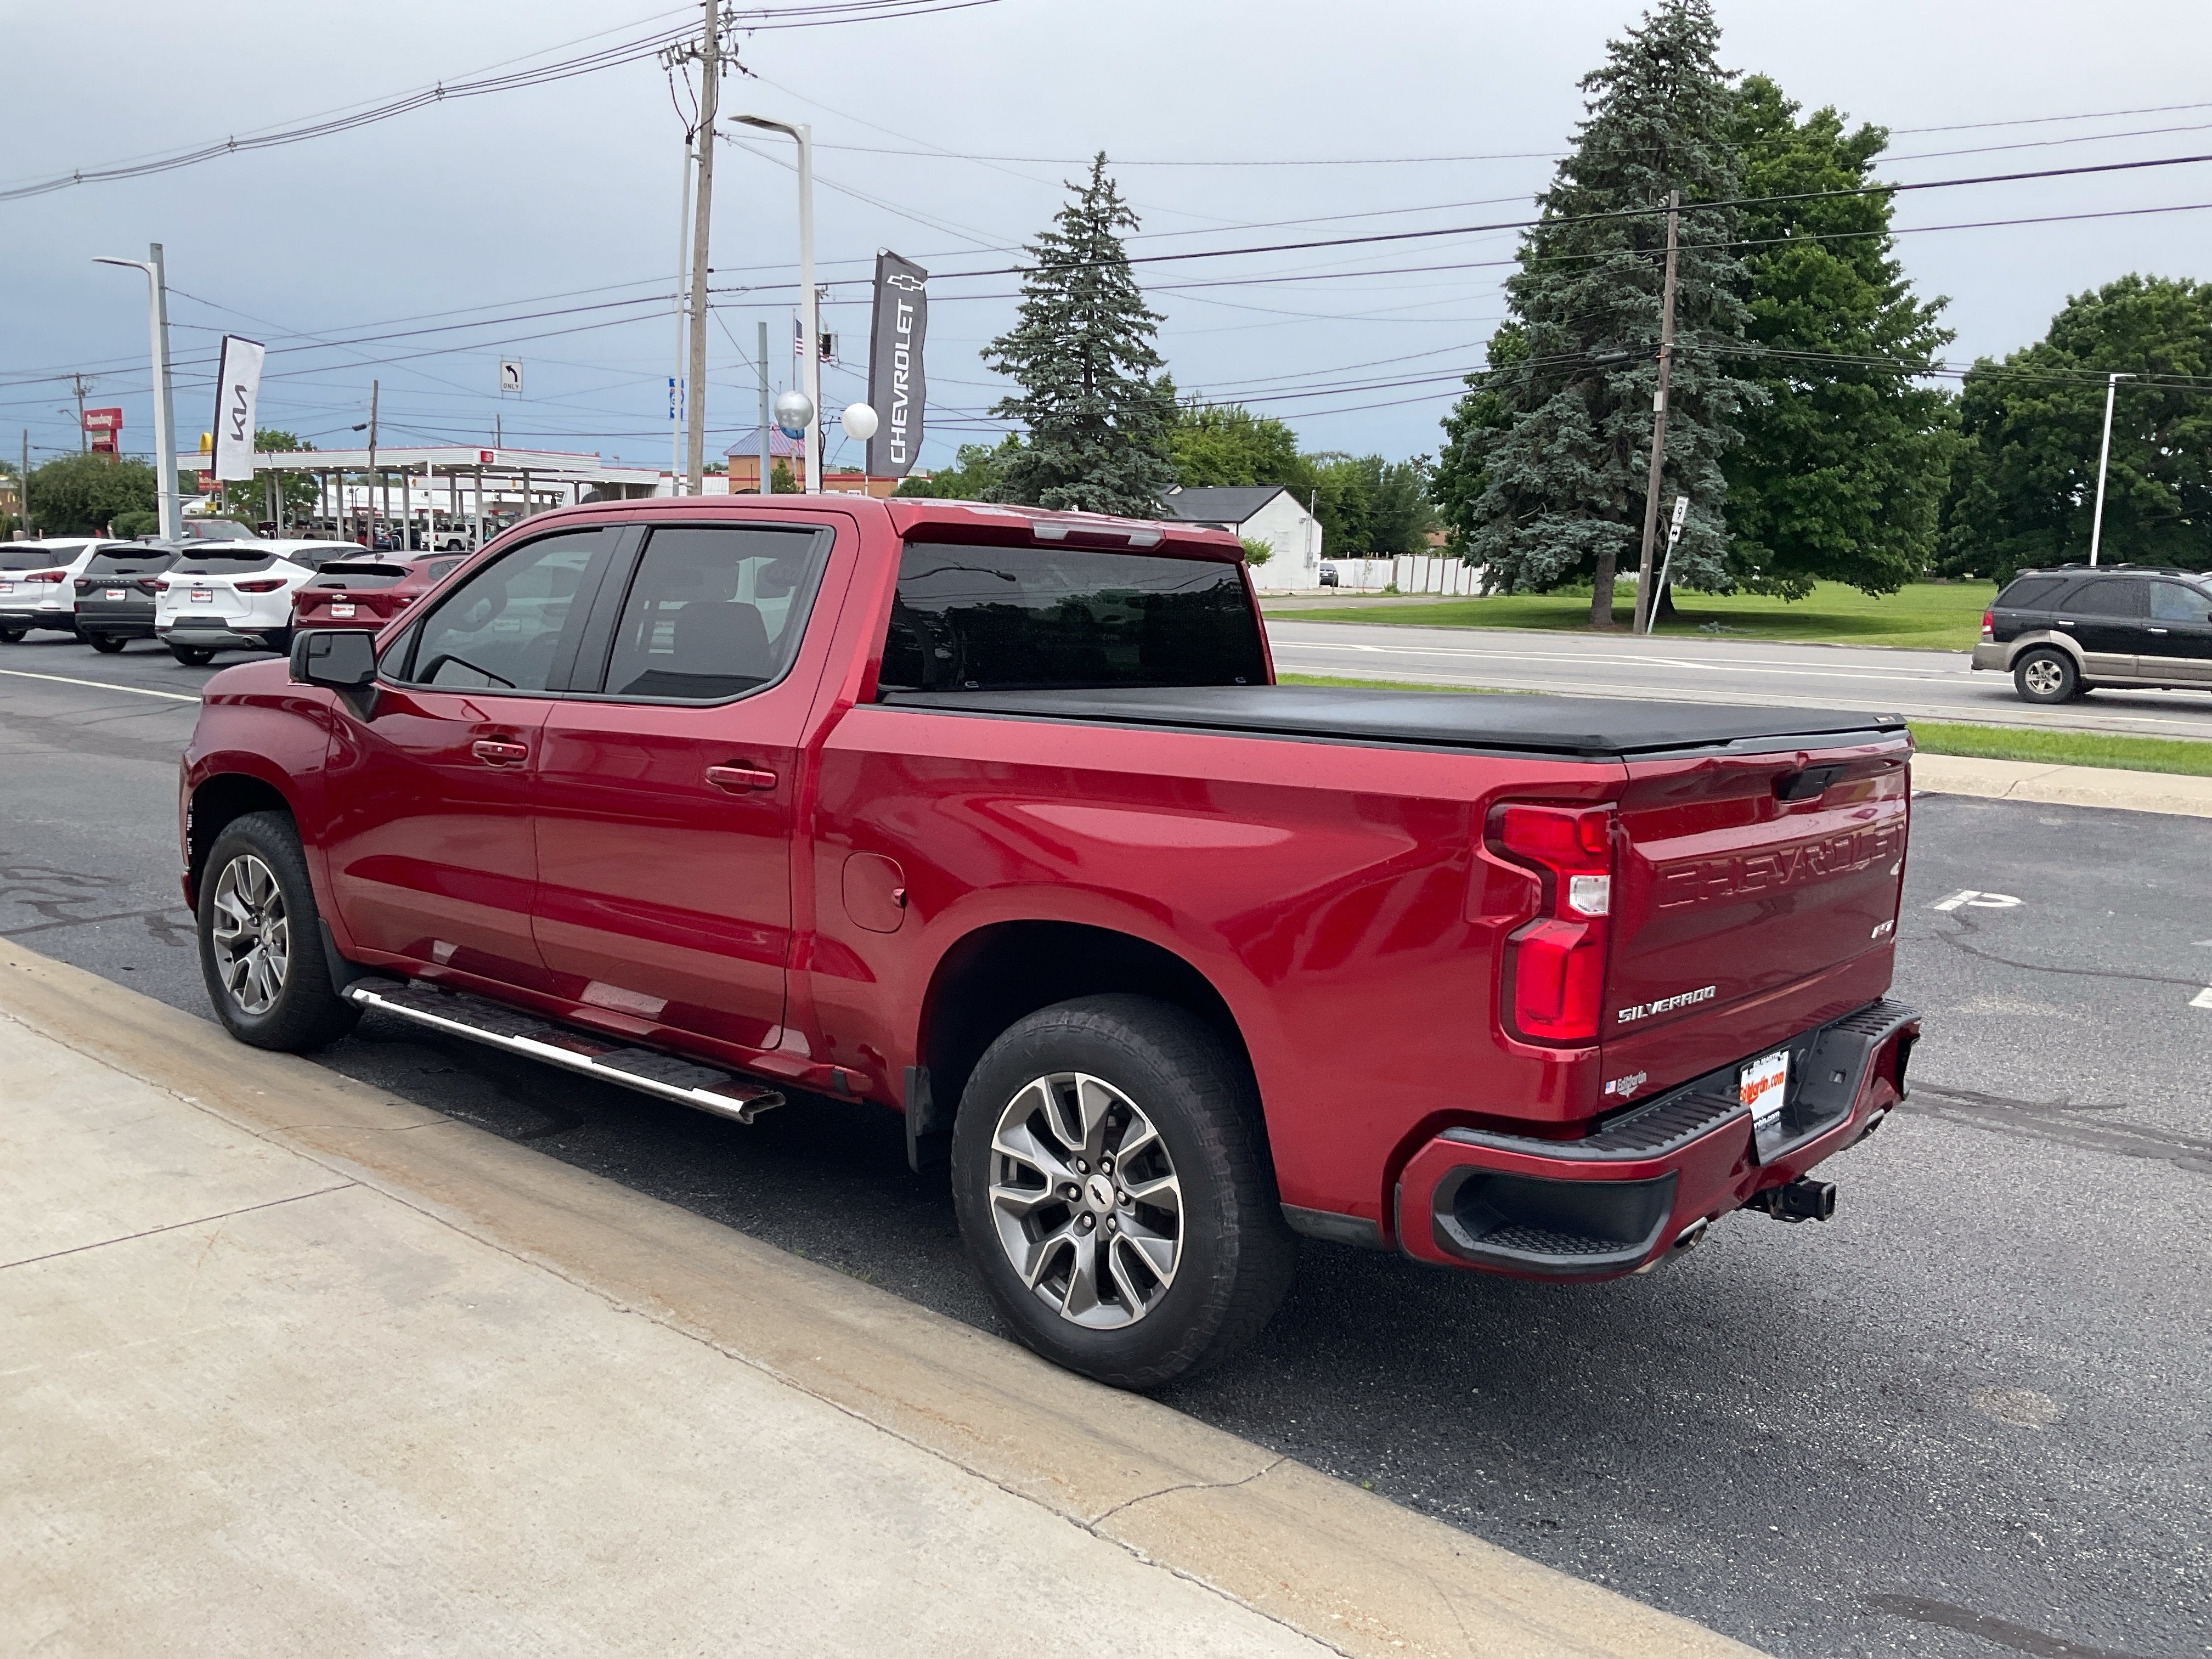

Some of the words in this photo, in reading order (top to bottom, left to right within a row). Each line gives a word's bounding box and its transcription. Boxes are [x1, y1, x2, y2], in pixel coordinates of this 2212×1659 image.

[891, 298, 913, 464] CHEVROLET
[1658, 823, 1905, 909] CHEVROLET
[1618, 985, 1716, 1023] SILVERADO
